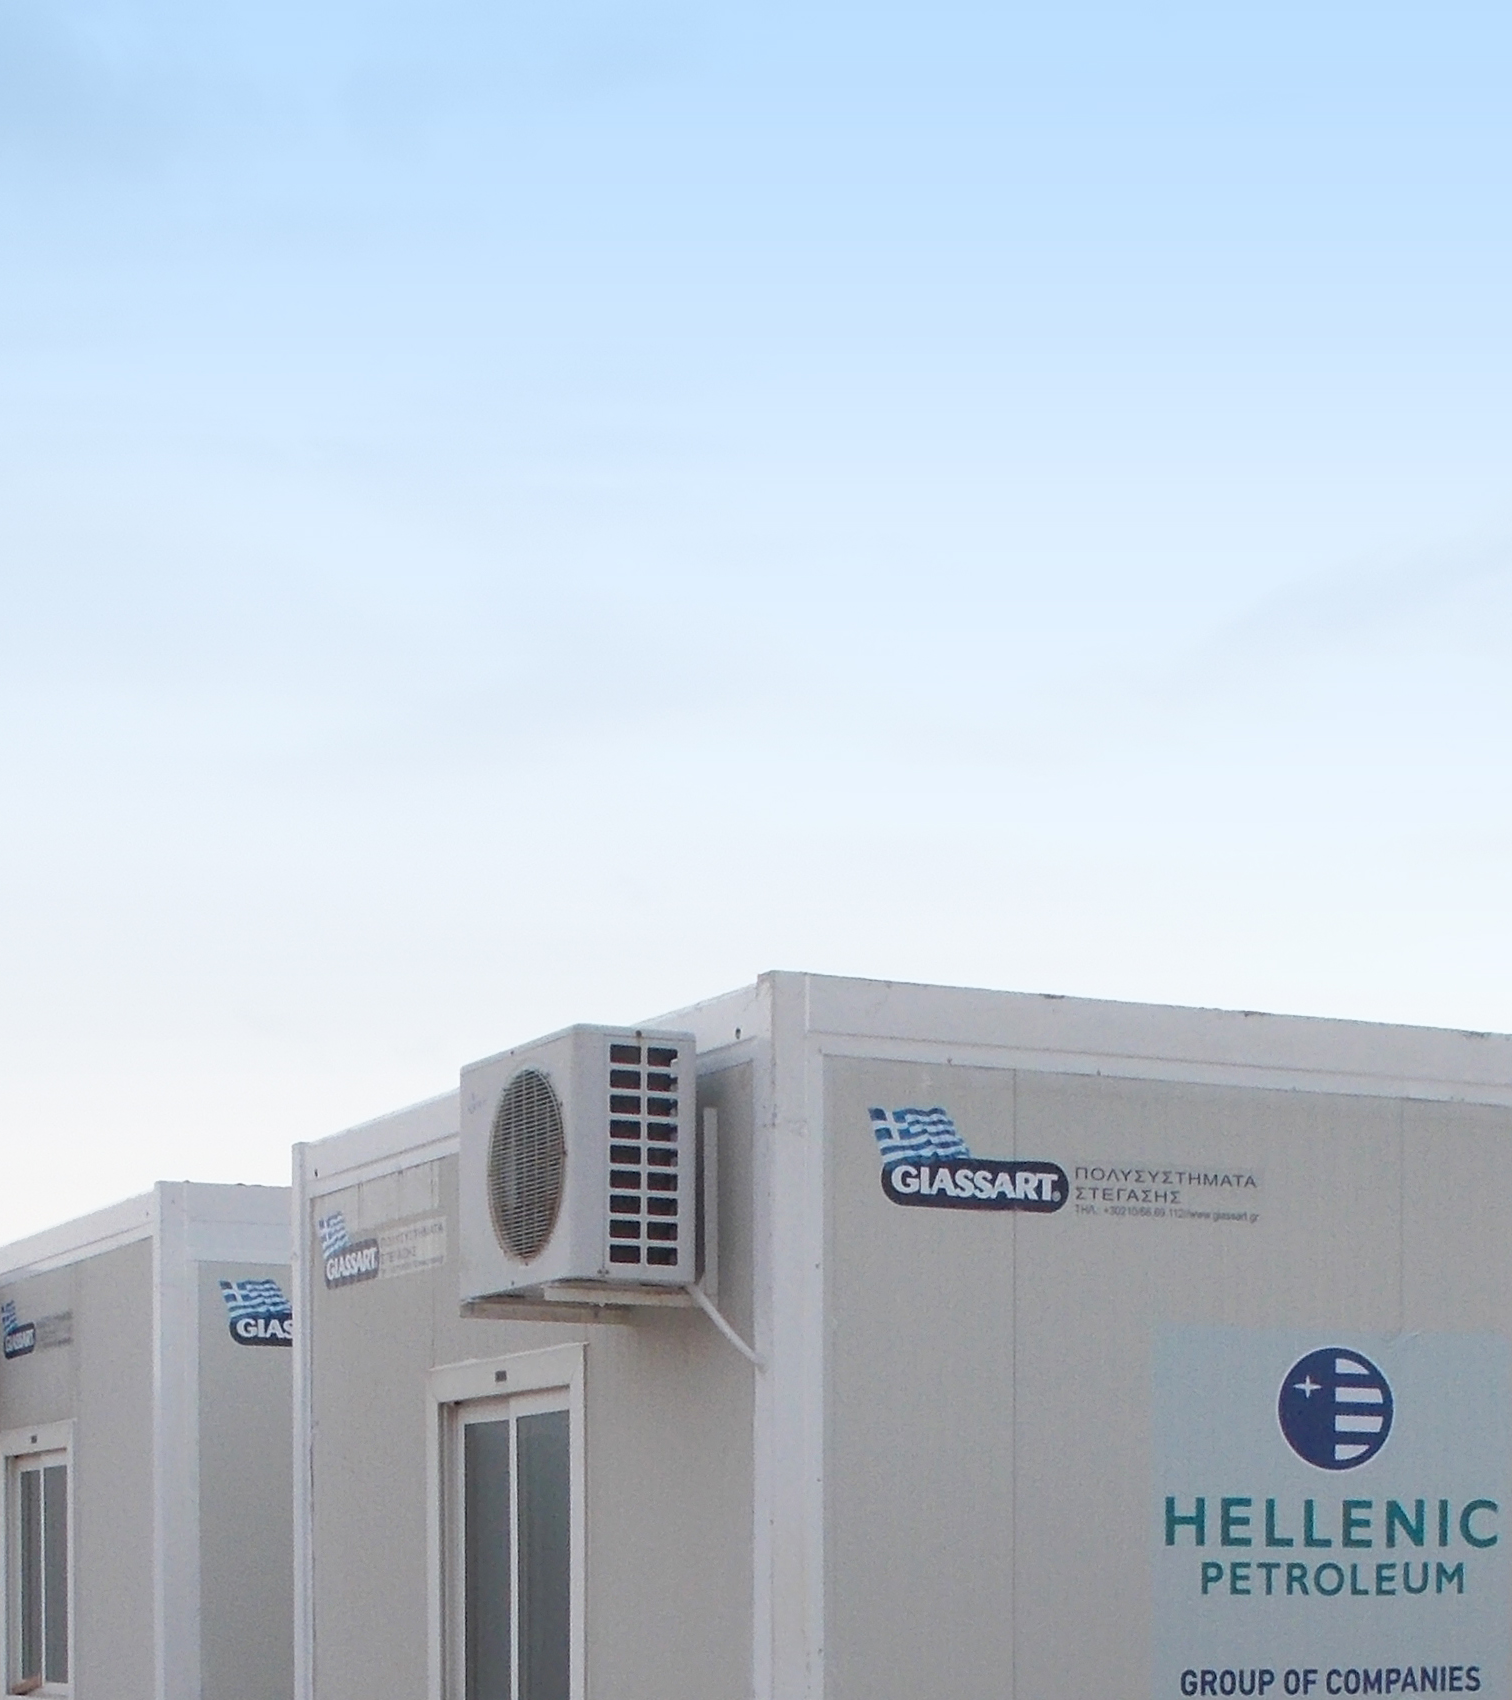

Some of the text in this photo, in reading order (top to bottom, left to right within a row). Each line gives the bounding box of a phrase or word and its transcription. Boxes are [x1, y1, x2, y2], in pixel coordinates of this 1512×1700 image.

[891, 1164, 1061, 1202] GIASSART
[1075, 1167, 1257, 1189] ΠΟΛΥΣΥΣΤΗΜΑΤΑ
[1075, 1186, 1182, 1204] ΣΤΕΓΑΣΗΣ
[326, 1246, 377, 1281] GIASSART
[236, 1318, 293, 1338] GIAS
[1164, 1496, 1499, 1549] HELLENIC
[1200, 1561, 1465, 1597] PETROLEUM
[1180, 1665, 1482, 1697] GROUP OF COMPANIES
